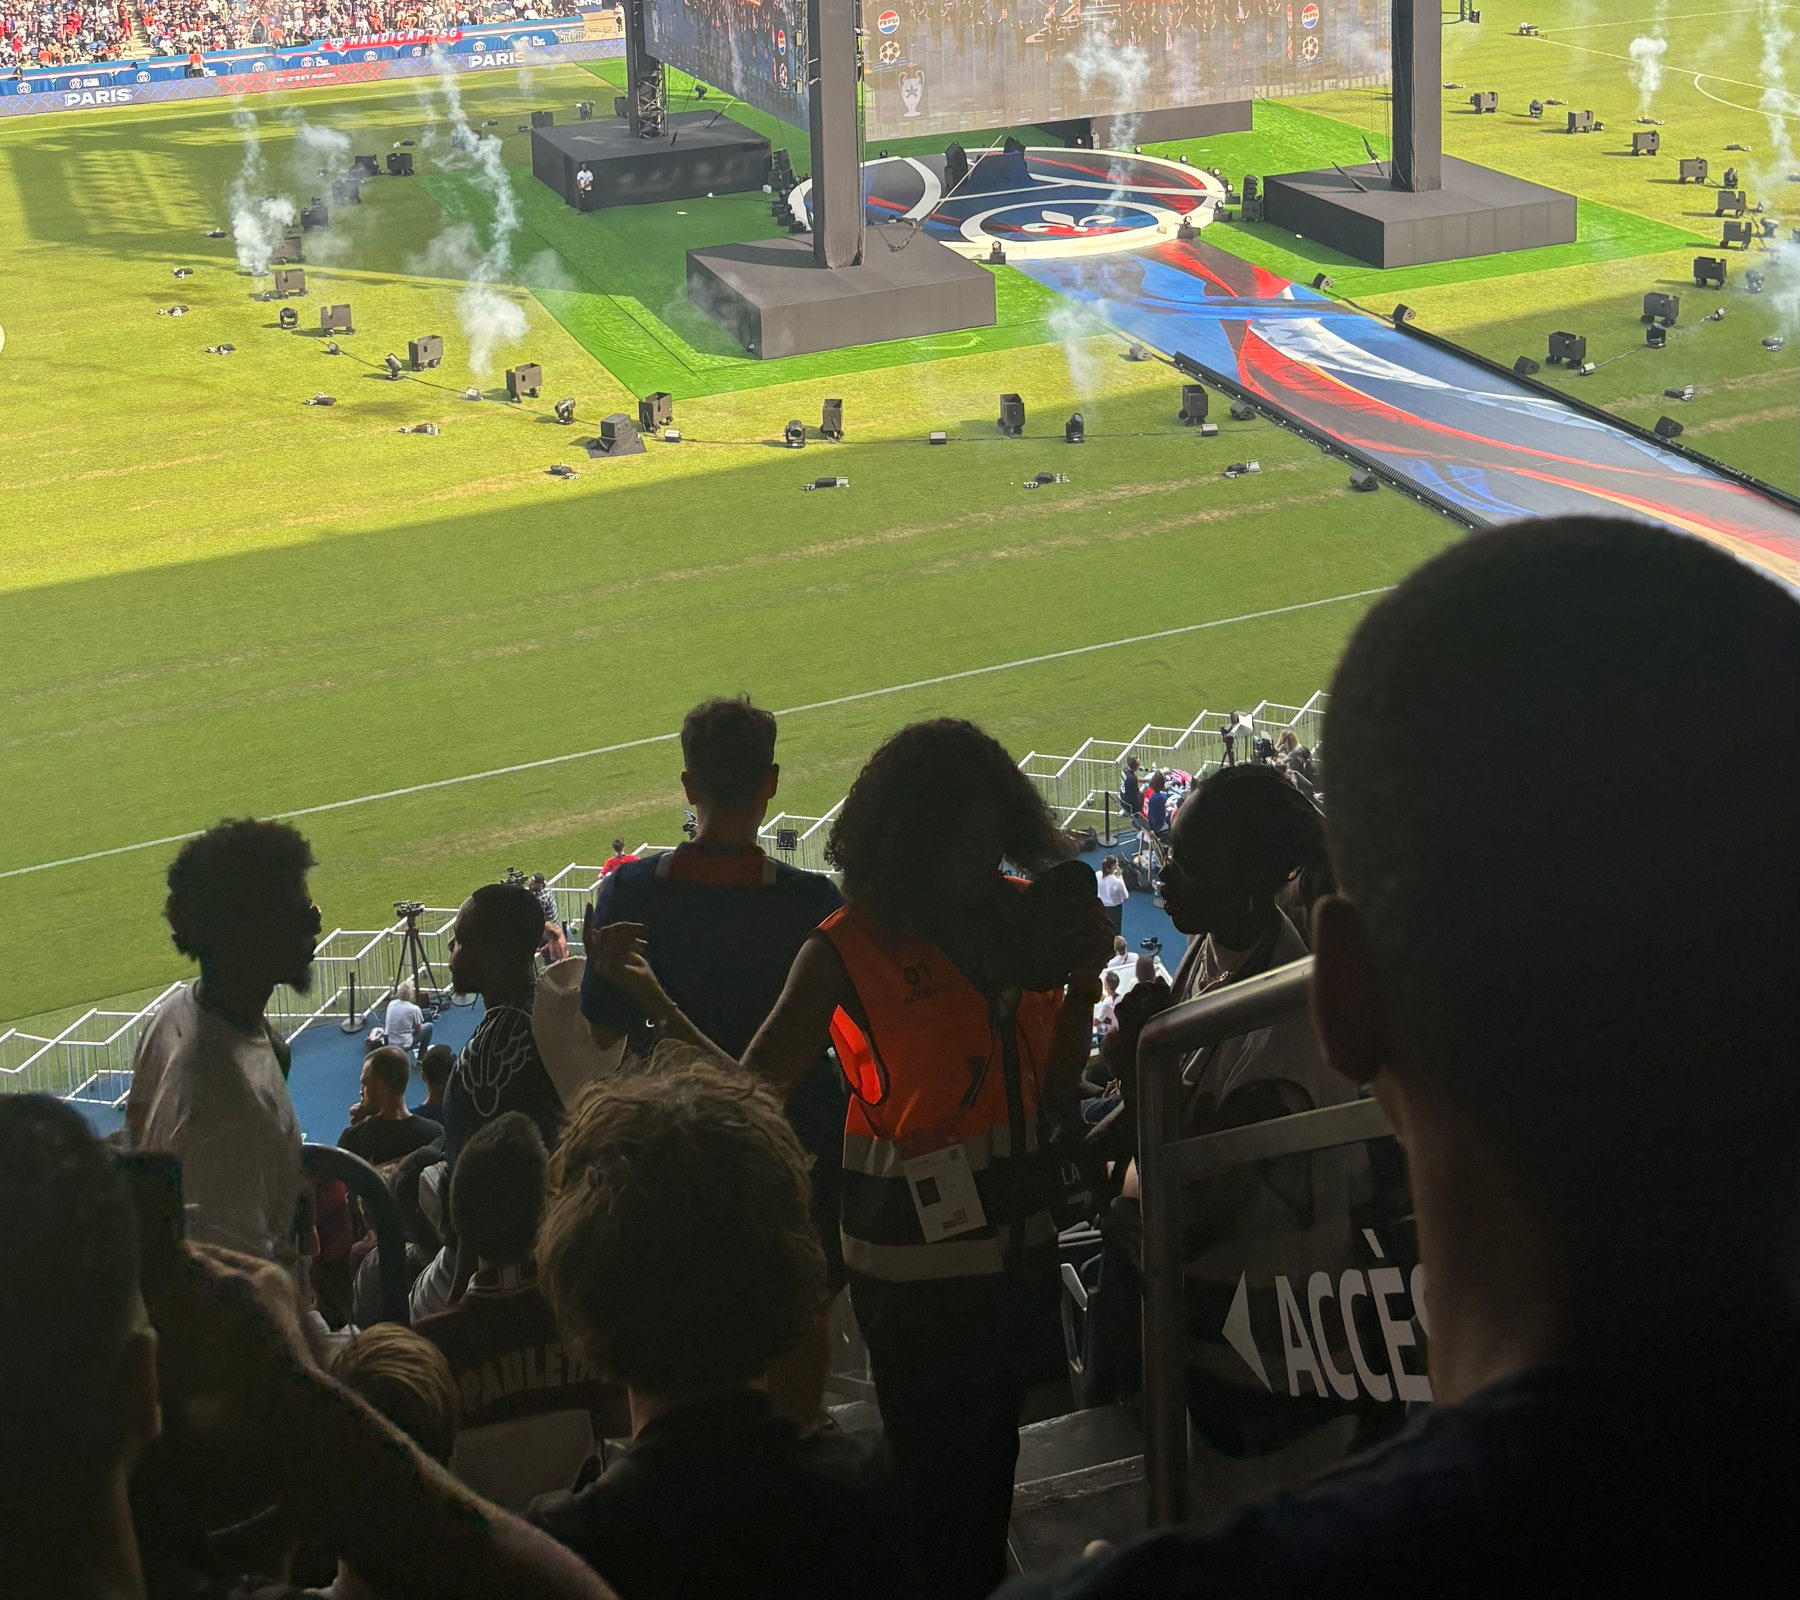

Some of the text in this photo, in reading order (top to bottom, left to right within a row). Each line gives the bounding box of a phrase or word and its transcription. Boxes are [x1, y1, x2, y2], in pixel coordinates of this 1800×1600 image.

[350, 28, 425, 46] HANDICAP
[470, 53, 526, 68] PARIS
[66, 88, 132, 107] PARIS
